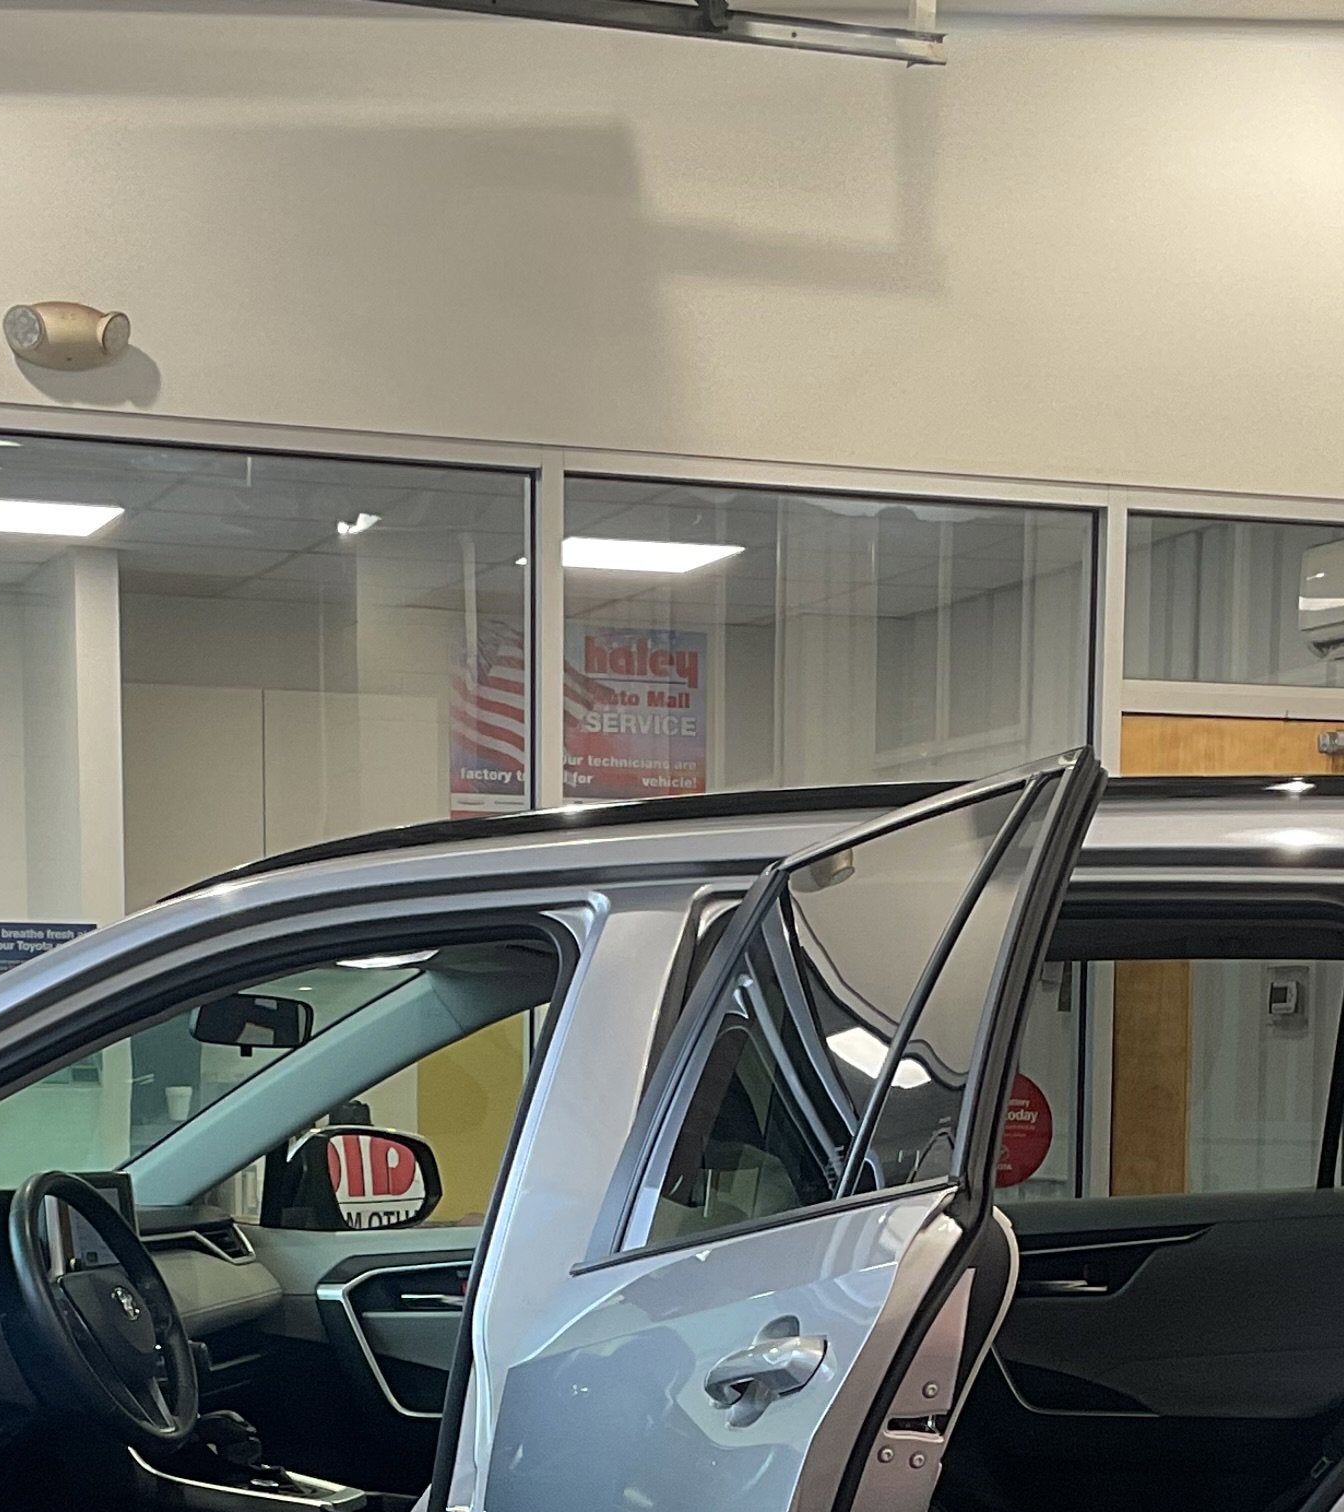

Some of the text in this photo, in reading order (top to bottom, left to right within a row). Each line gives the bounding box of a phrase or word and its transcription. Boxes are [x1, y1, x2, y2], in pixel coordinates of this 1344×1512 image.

[585, 635, 698, 689] haley
[647, 691, 690, 709] Mall
[584, 711, 697, 737] SERVICE
[588, 755, 670, 770] technicians
[674, 761, 697, 771] are
[460, 767, 512, 784] factory
[572, 771, 594, 785] for
[642, 775, 697, 789] vehicle!
[1, 928, 45, 940] breathe
[46, 929, 75, 940] fresh
[17, 940, 54, 953] Toyota
[1006, 1109, 1039, 1124] oday
